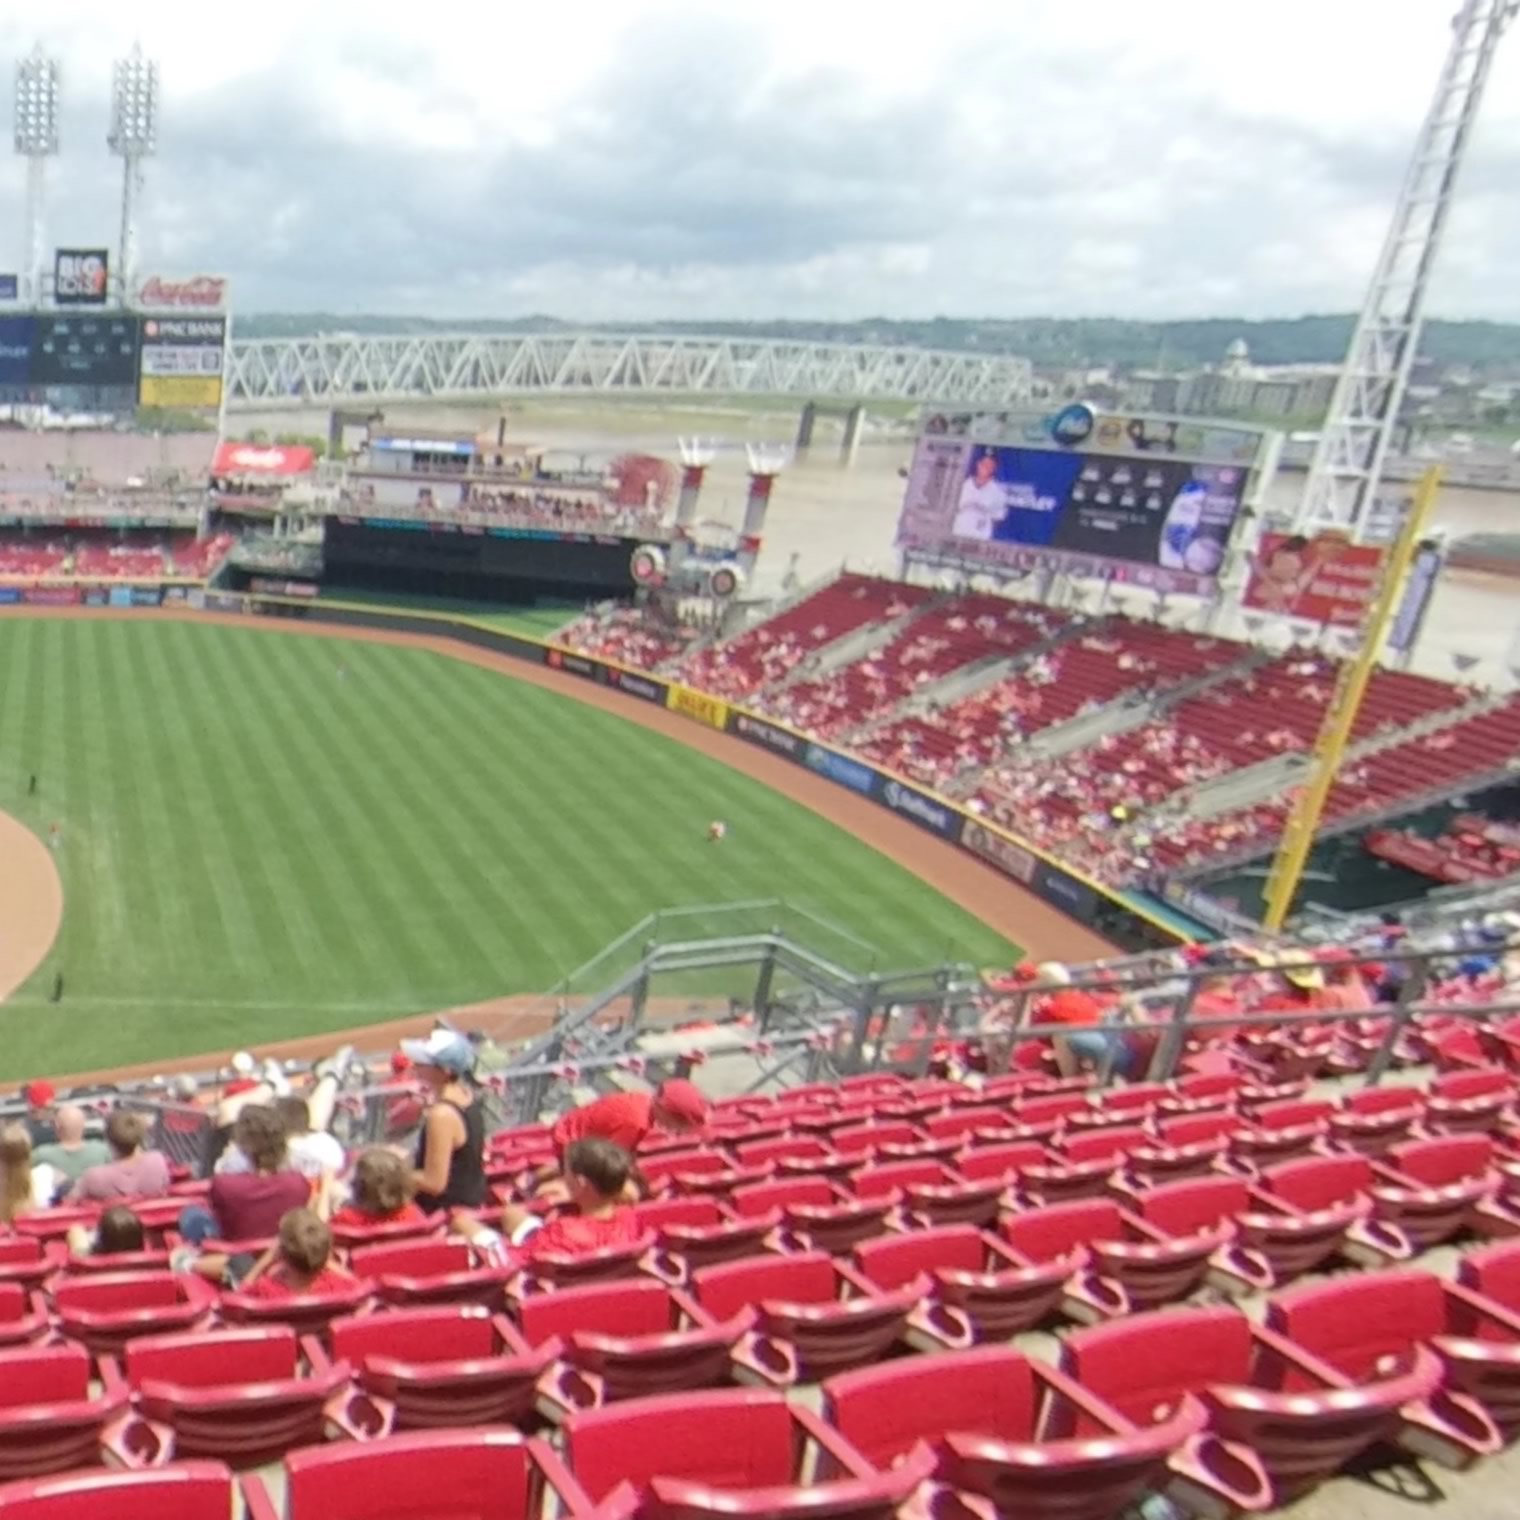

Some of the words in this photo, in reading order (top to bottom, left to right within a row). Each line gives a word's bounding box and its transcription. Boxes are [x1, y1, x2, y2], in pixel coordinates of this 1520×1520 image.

[59, 256, 102, 277] BIG
[140, 274, 225, 305] Coca-Cola
[159, 321, 187, 337] PNC
[187, 321, 224, 337] BANK
